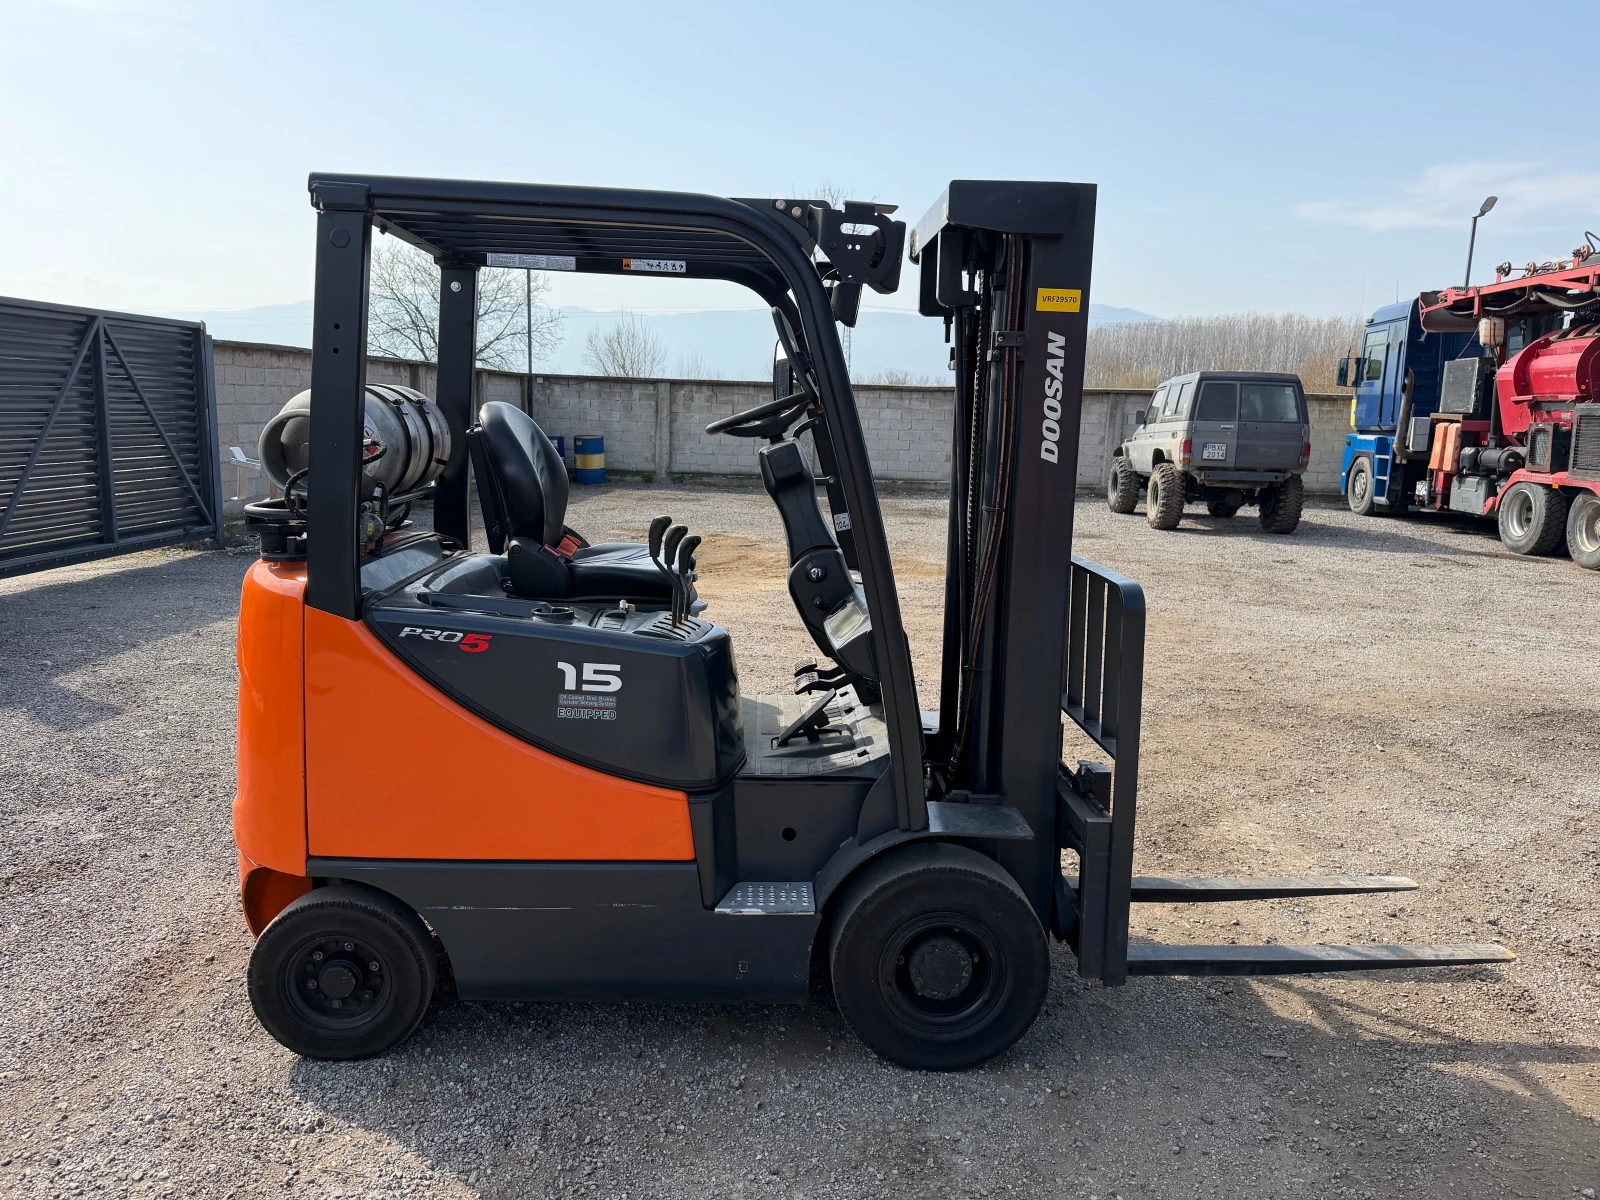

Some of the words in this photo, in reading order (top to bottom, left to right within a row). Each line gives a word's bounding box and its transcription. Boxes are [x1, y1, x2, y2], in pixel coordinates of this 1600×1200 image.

[1042, 296, 1078, 304] VRF29570
[1040, 331, 1066, 464] DOOSAN
[558, 662, 622, 692] 15
[558, 708, 616, 720] EQUIPPED
